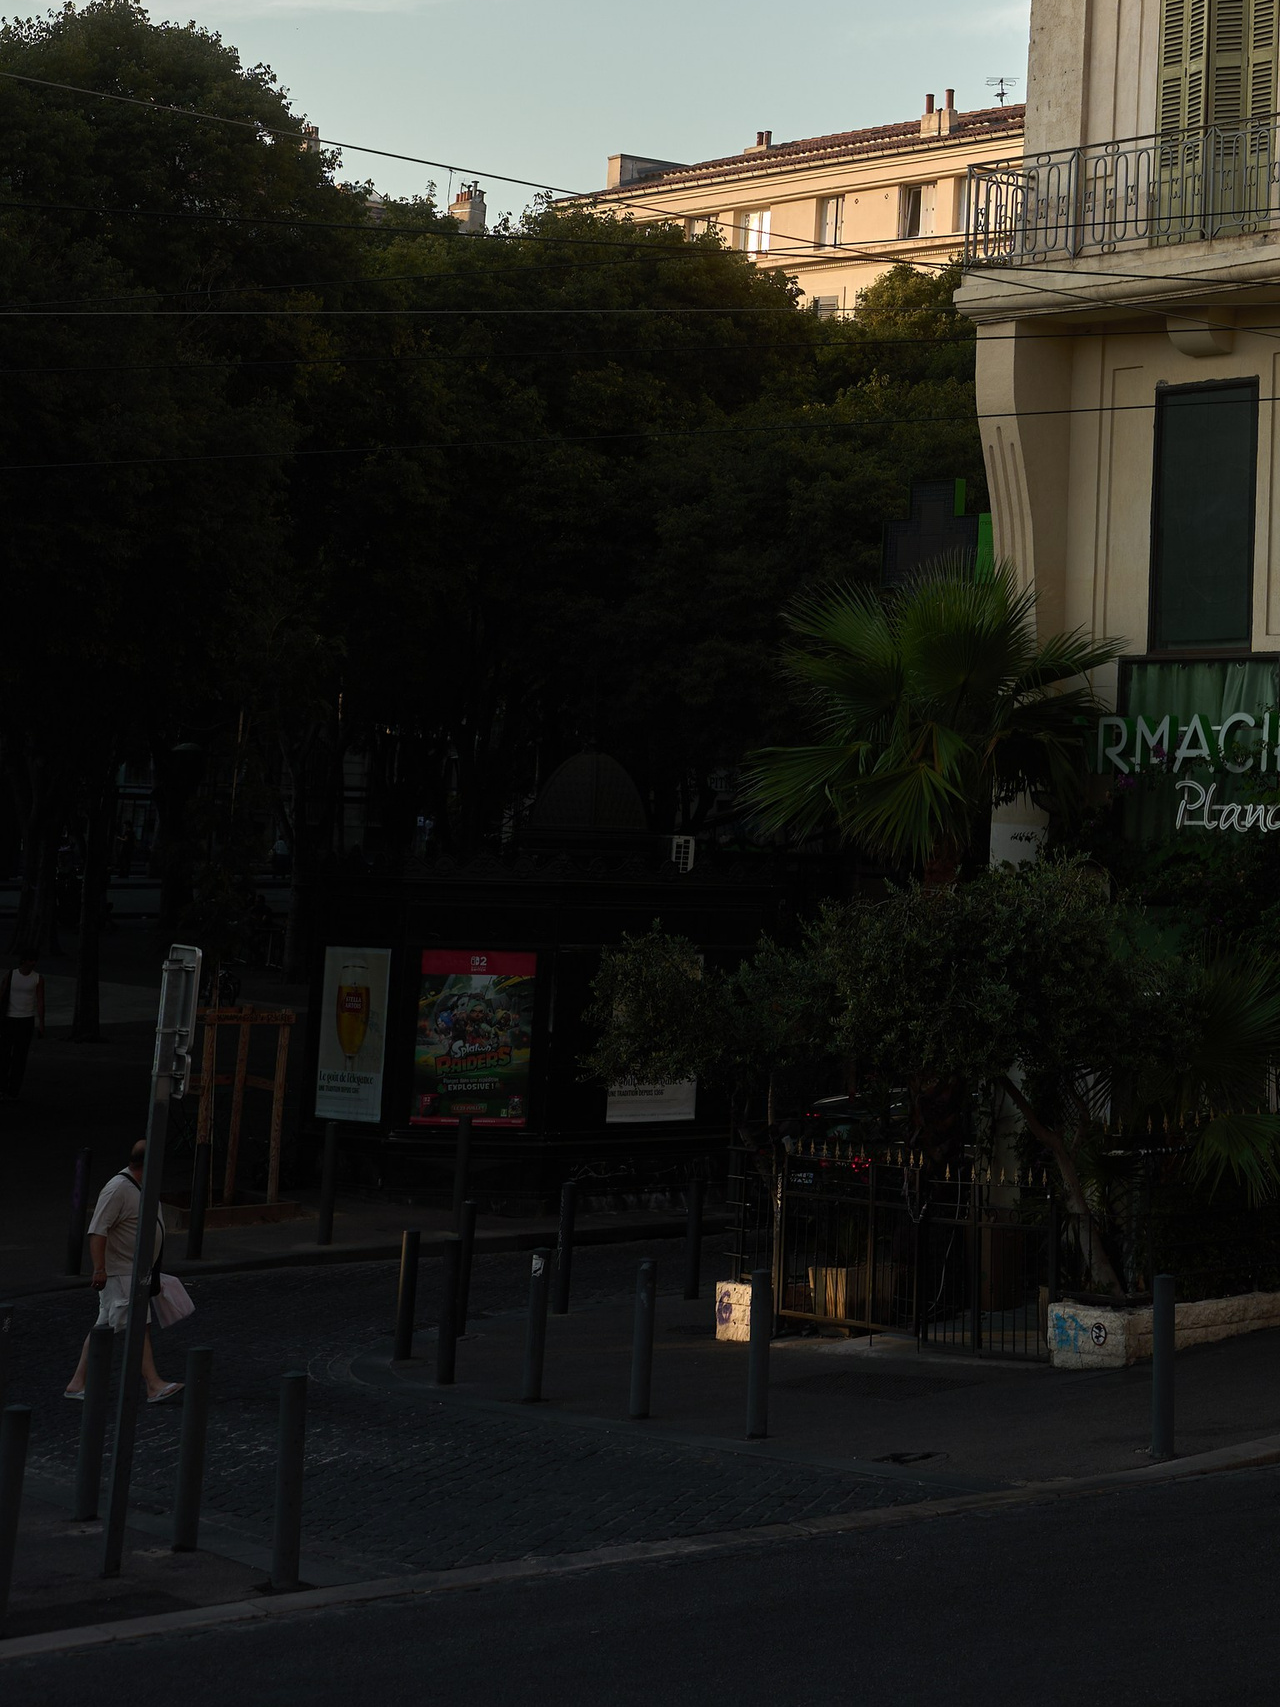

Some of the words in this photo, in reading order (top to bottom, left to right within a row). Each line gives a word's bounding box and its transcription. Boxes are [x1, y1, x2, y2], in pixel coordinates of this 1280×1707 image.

[451, 1039, 492, 1059] Splatoon
[435, 1046, 513, 1076] RAIDERS
[448, 1083, 491, 1091] EXPLOSIVE
